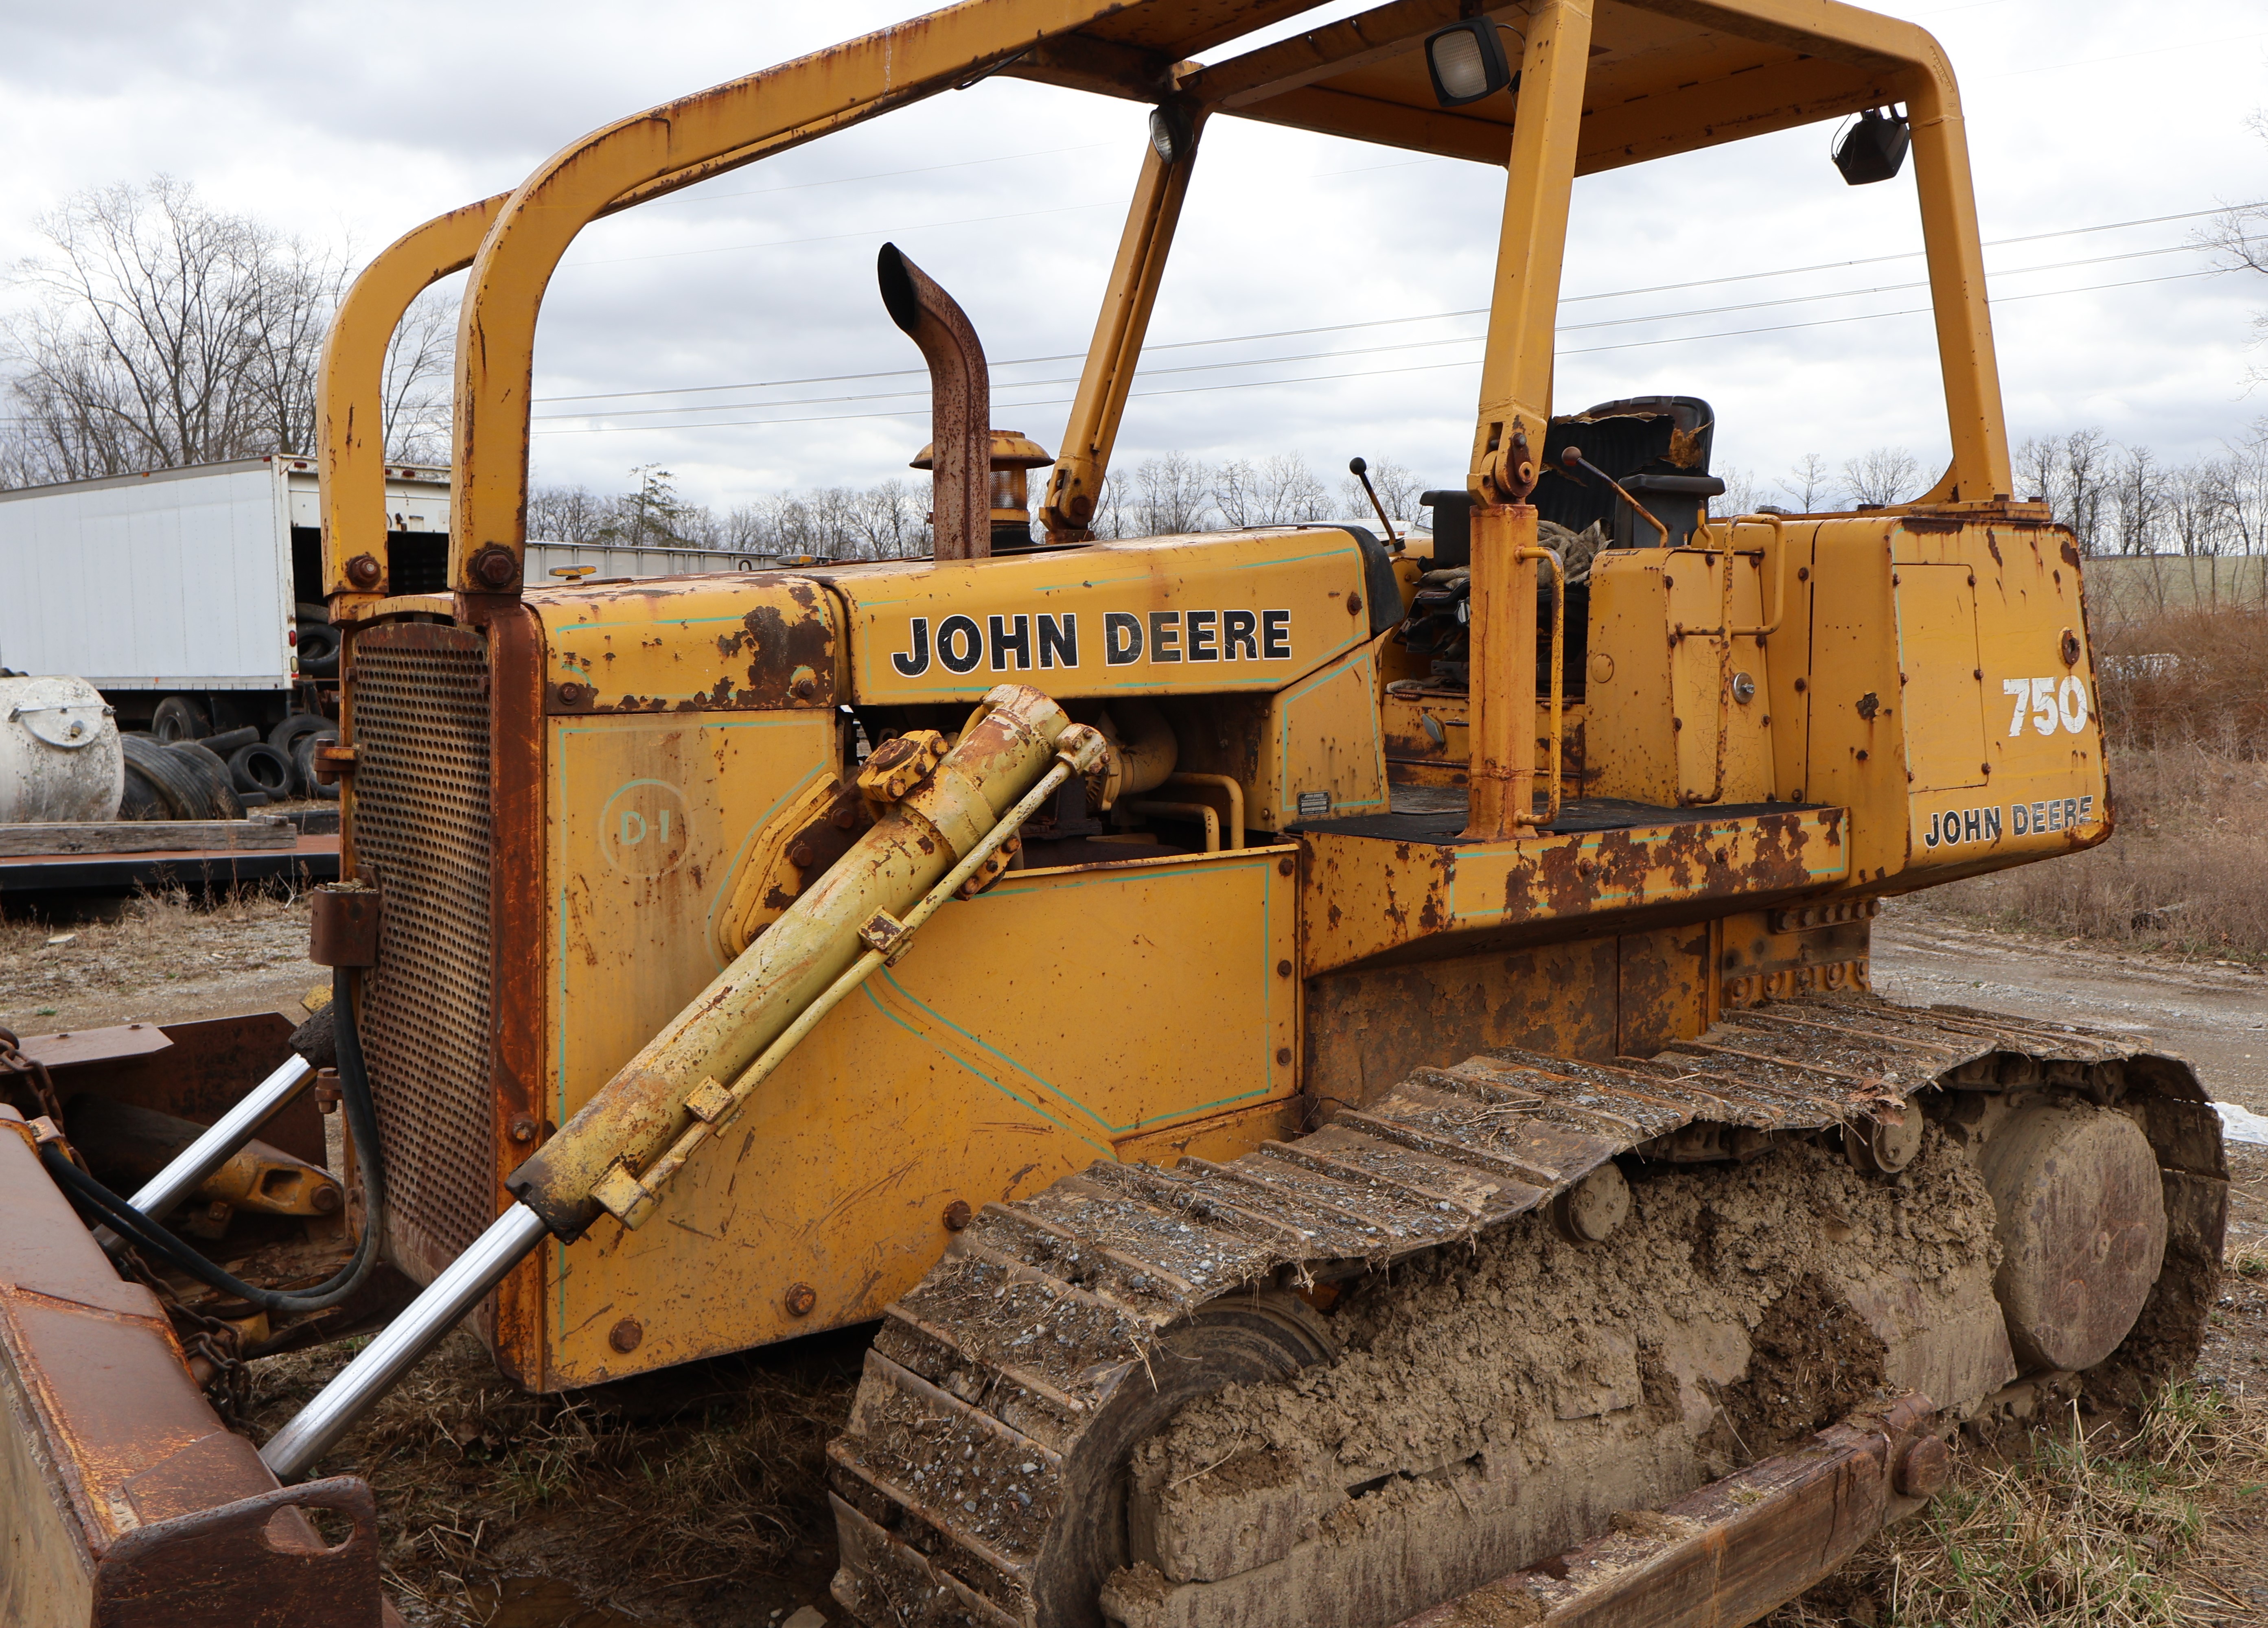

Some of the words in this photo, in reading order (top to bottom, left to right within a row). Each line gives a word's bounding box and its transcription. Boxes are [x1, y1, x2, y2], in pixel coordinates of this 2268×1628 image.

[891, 613, 1079, 678] JOHN
[1103, 609, 1292, 667] DEERE
[2003, 675, 2087, 737] 750
[1924, 805, 2001, 848] JOHN
[2011, 795, 2093, 836] DEERE
